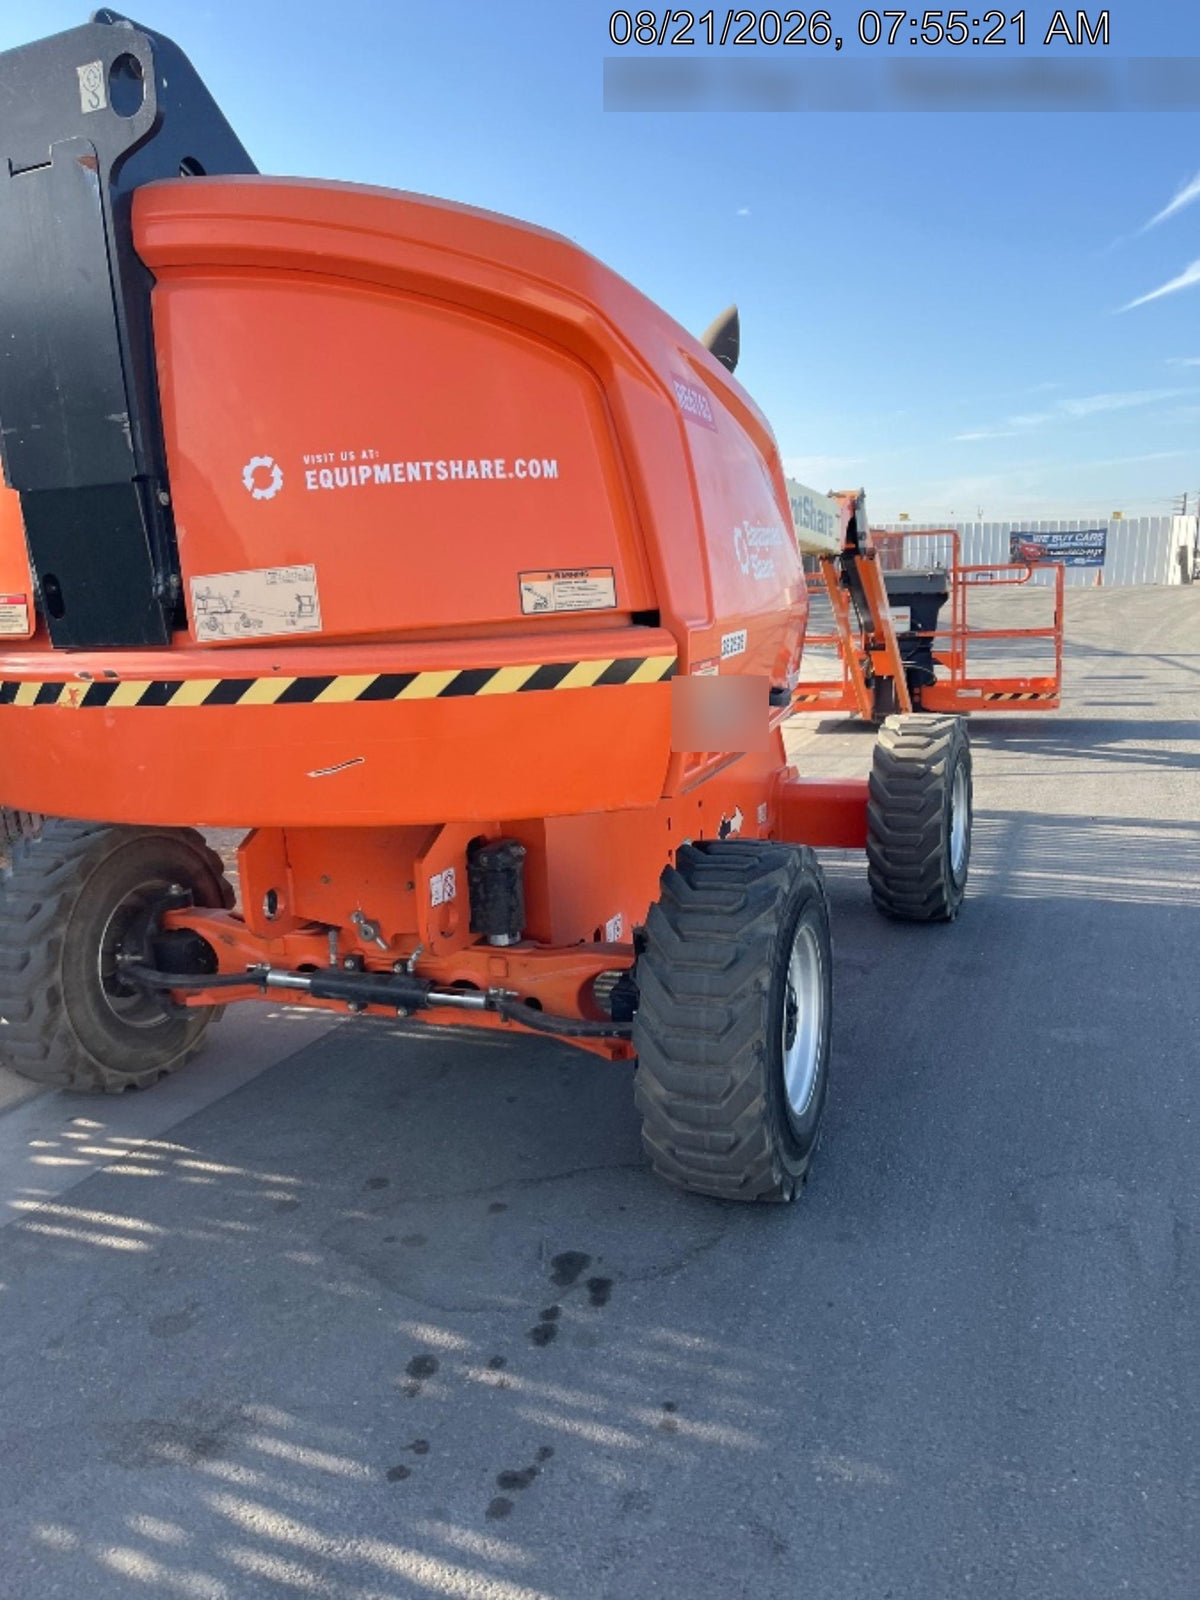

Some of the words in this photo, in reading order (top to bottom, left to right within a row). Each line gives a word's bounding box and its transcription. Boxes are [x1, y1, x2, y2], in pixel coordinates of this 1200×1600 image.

[303, 452, 335, 465] VISIT
[340, 450, 356, 462] US
[361, 449, 380, 460] AT:
[305, 458, 560, 491] EQUIPMENTSHARE.COM
[1052, 533, 1074, 543] BUY
[1075, 532, 1105, 542] CARS
